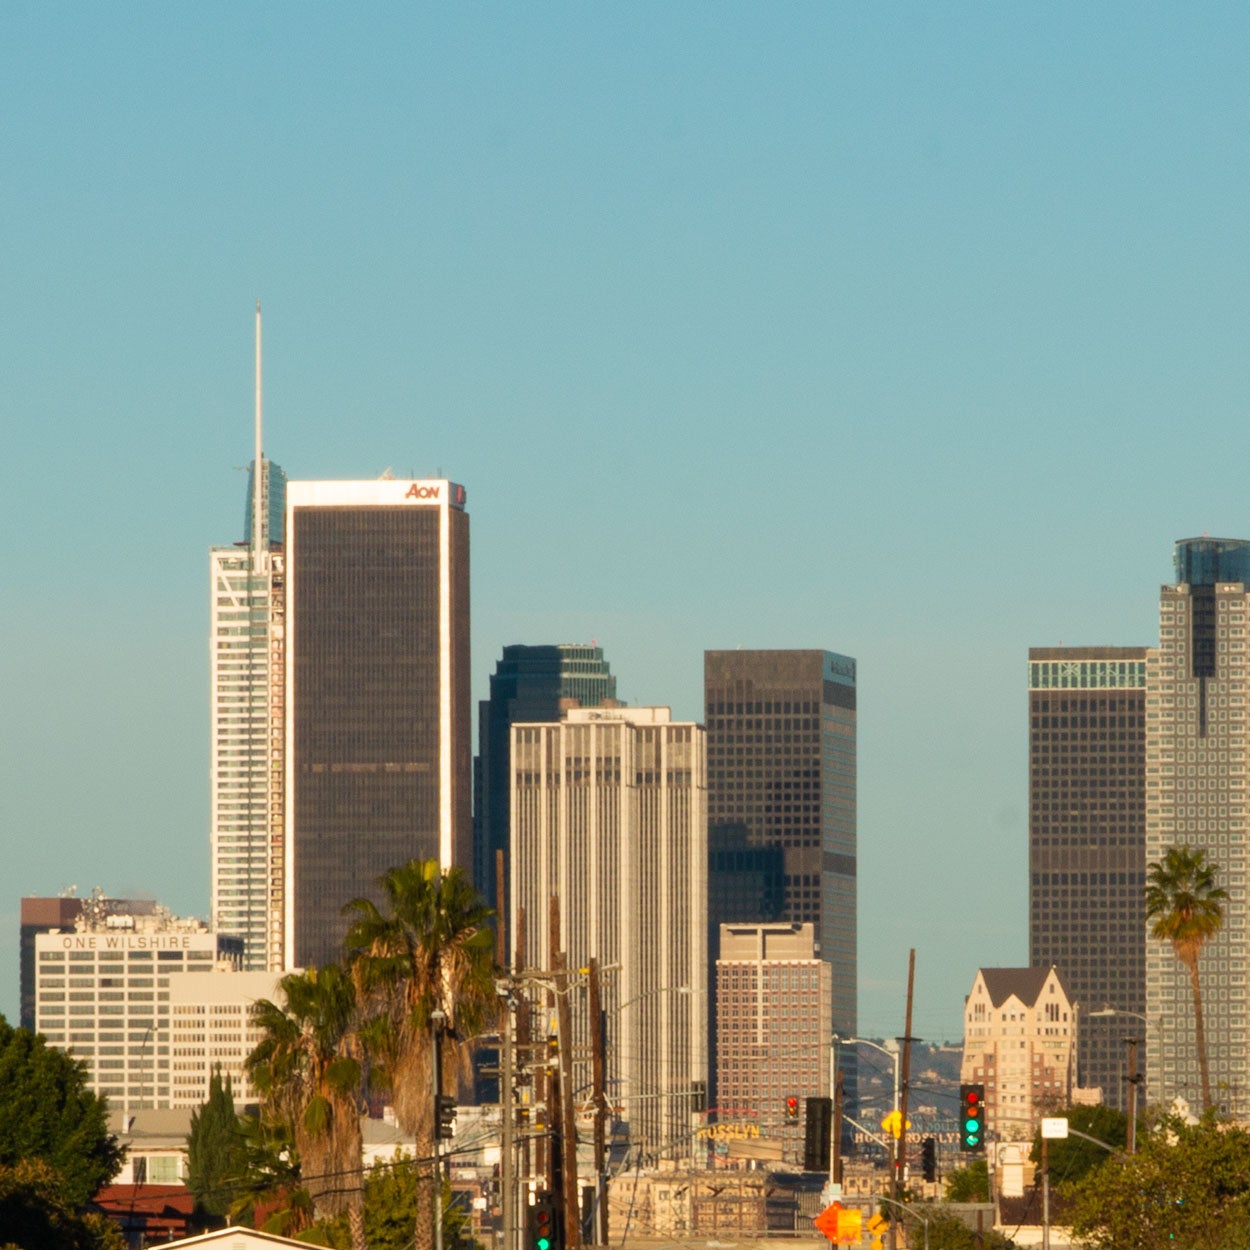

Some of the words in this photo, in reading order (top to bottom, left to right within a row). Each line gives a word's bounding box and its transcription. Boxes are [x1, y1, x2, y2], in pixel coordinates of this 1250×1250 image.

[63, 937, 96, 949] ONE
[106, 937, 191, 949] WILSHIRE
[854, 1132, 893, 1144] HOTE
